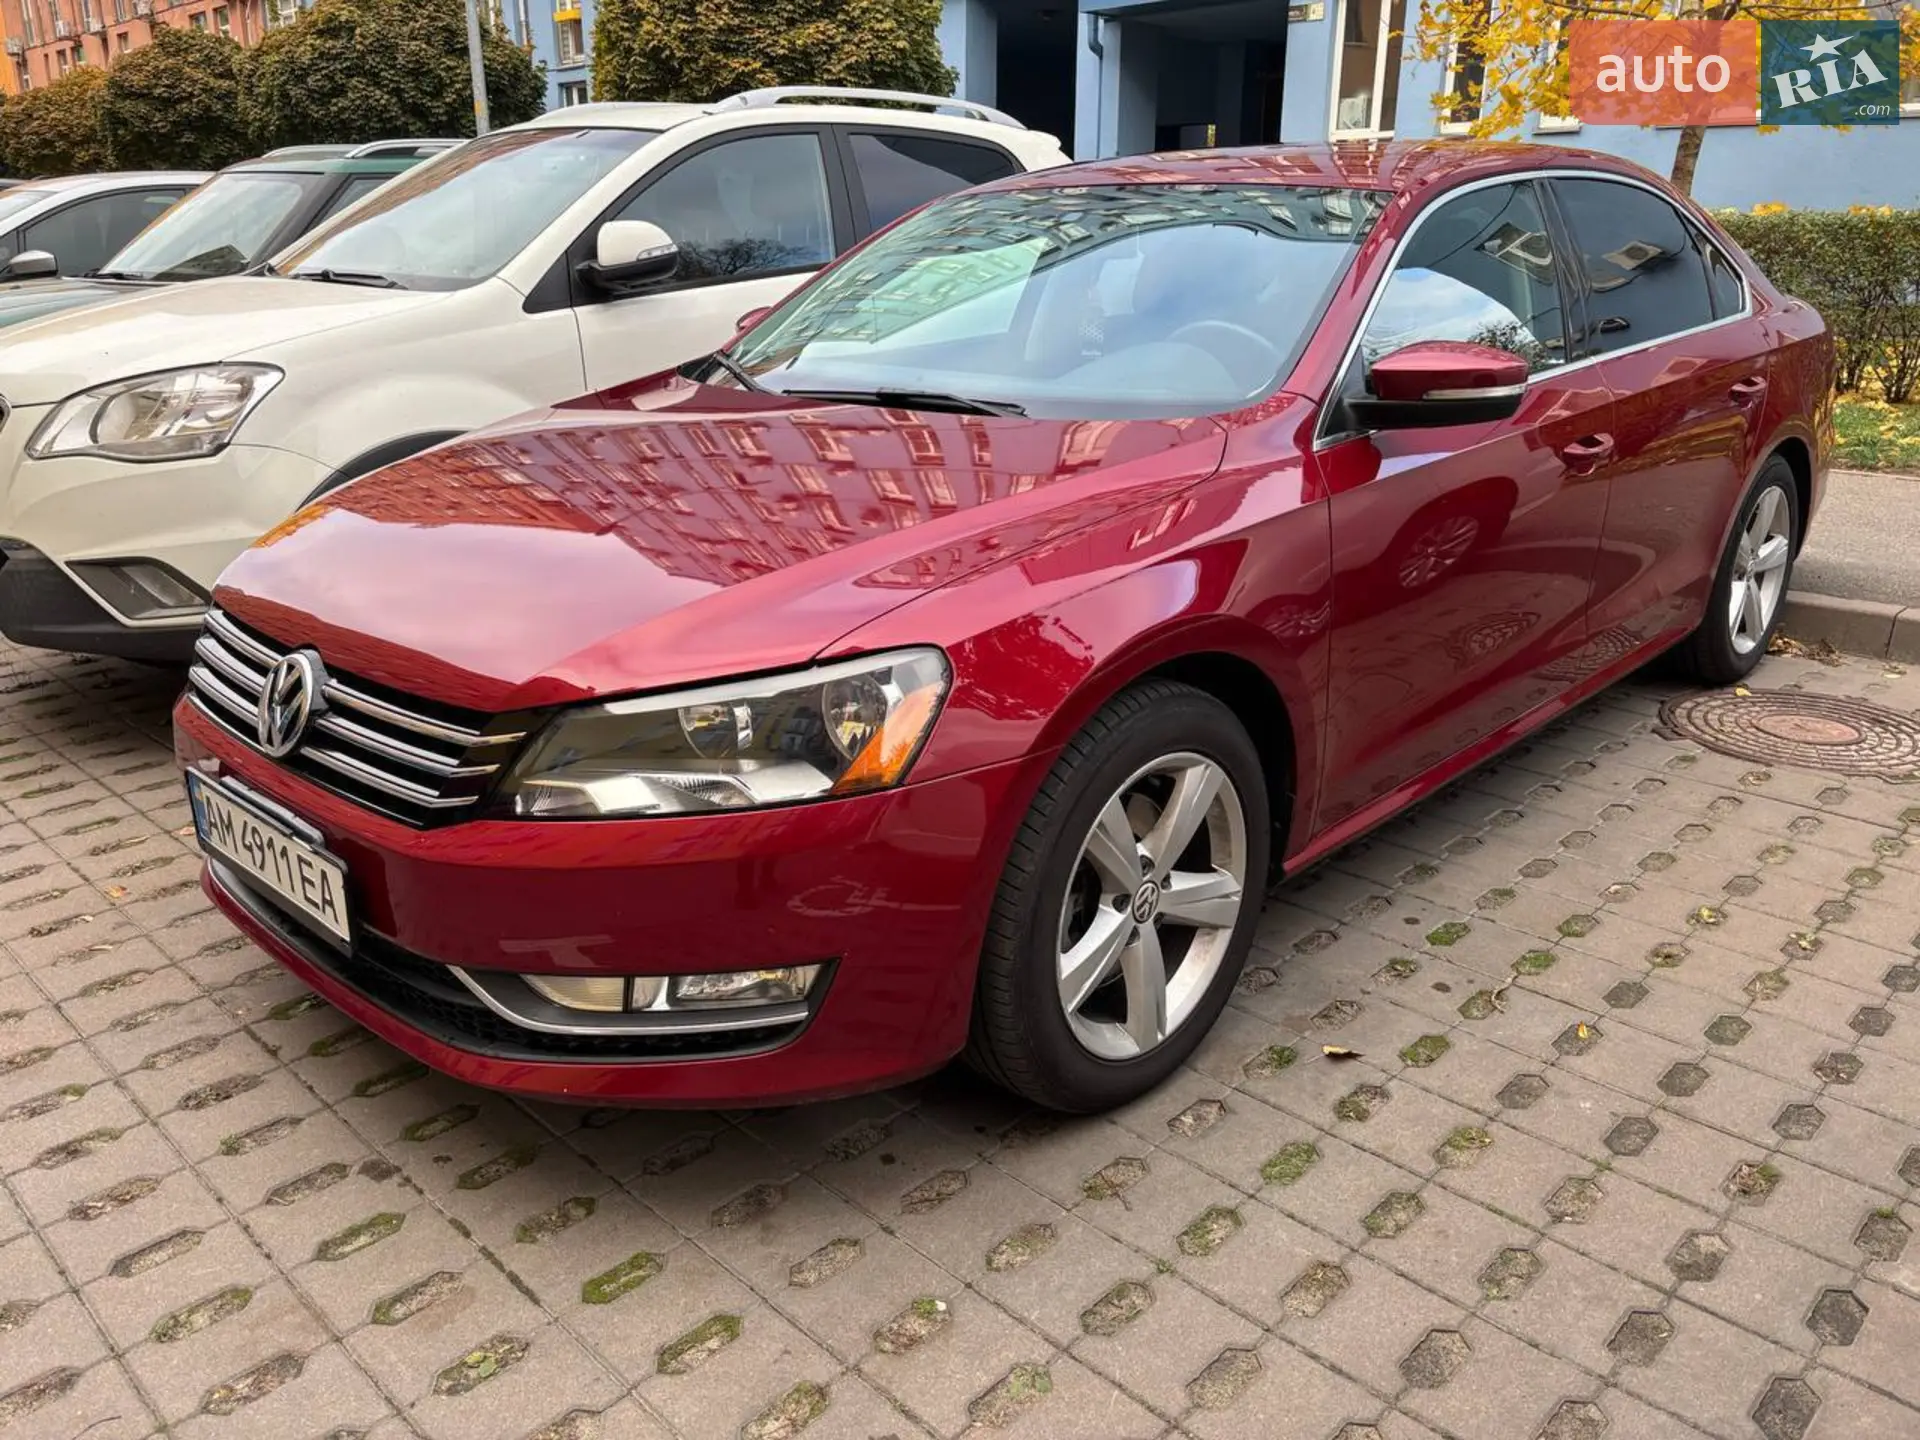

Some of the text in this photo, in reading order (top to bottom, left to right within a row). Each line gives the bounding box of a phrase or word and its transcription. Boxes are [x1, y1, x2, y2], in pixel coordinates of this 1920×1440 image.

[205, 795, 339, 924] AM 4911 EA
